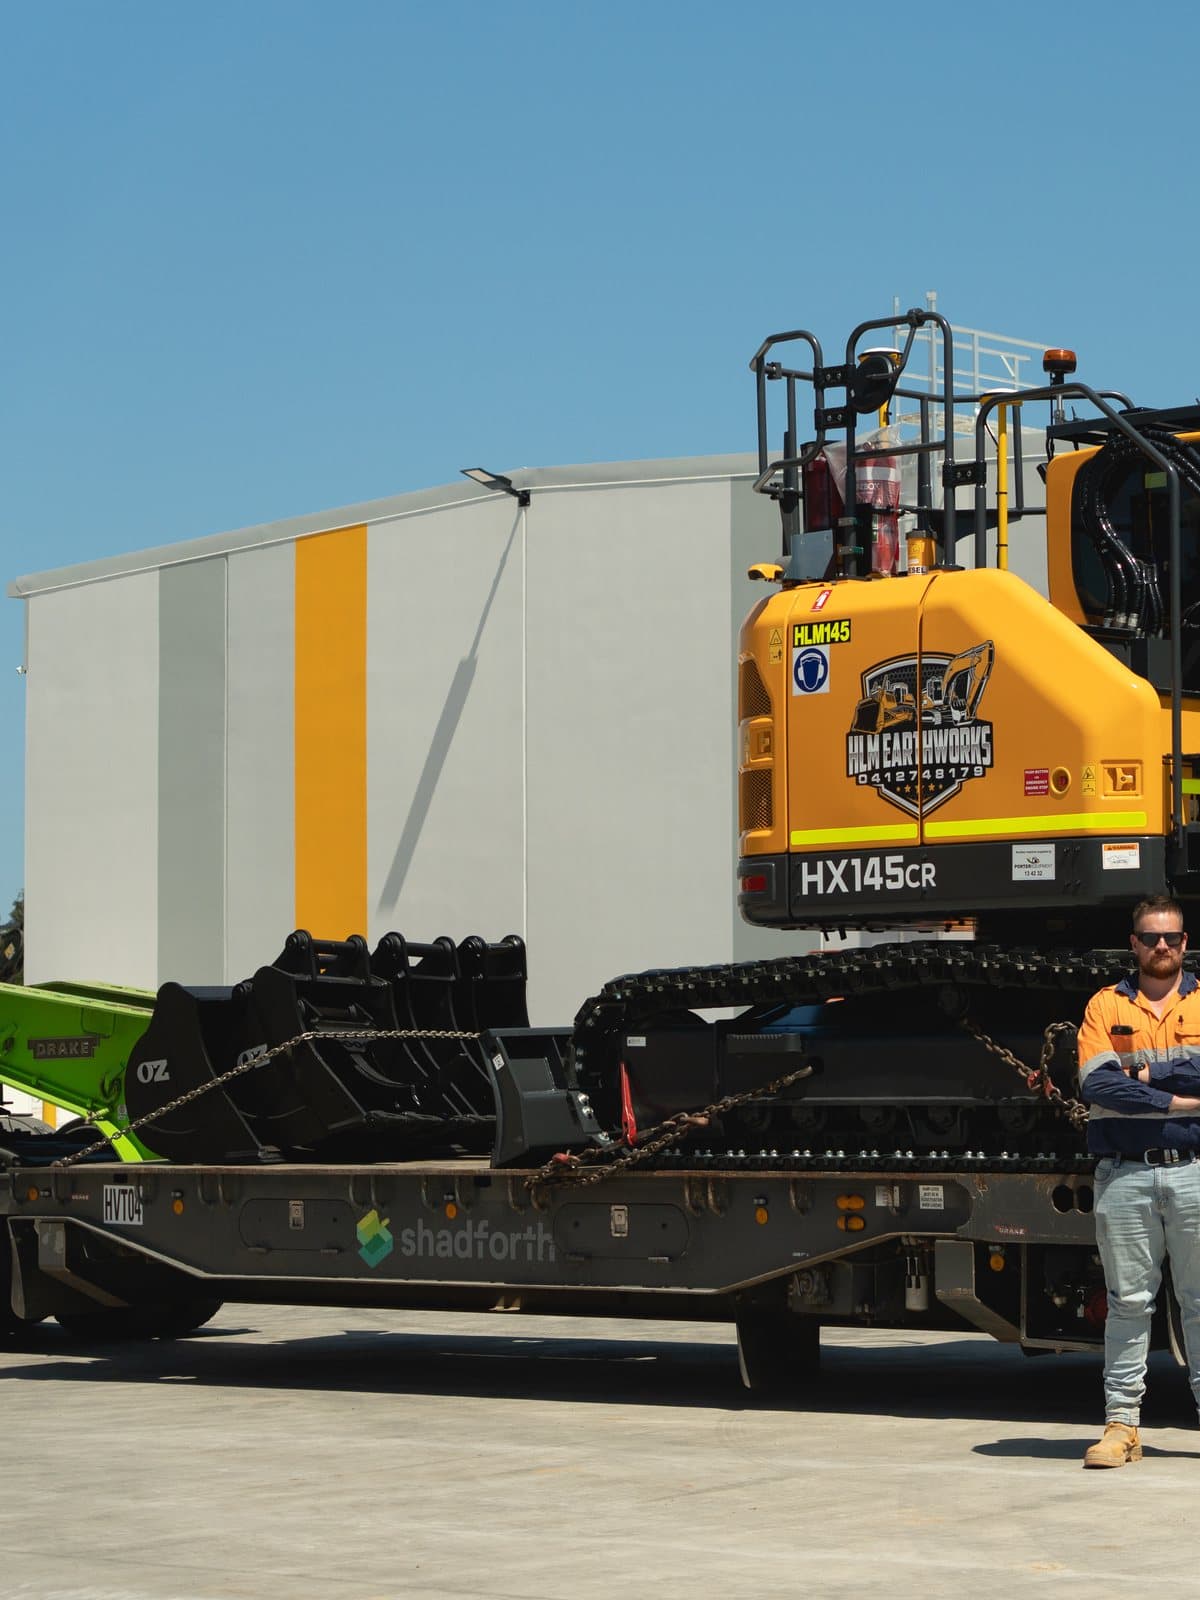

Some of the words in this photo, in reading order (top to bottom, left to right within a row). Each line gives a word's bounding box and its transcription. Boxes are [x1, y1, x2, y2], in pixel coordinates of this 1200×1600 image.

[794, 621, 850, 646] HLM145
[848, 734, 880, 775] HLM
[882, 725, 992, 769] EARTHWORKS
[858, 765, 984, 784] 0412748179
[801, 855, 937, 895] HX145CR
[36, 1041, 90, 1055] DRAKE
[136, 1059, 171, 1084] OZ
[105, 1188, 142, 1222] HVT04
[401, 1218, 556, 1262] shadforth
